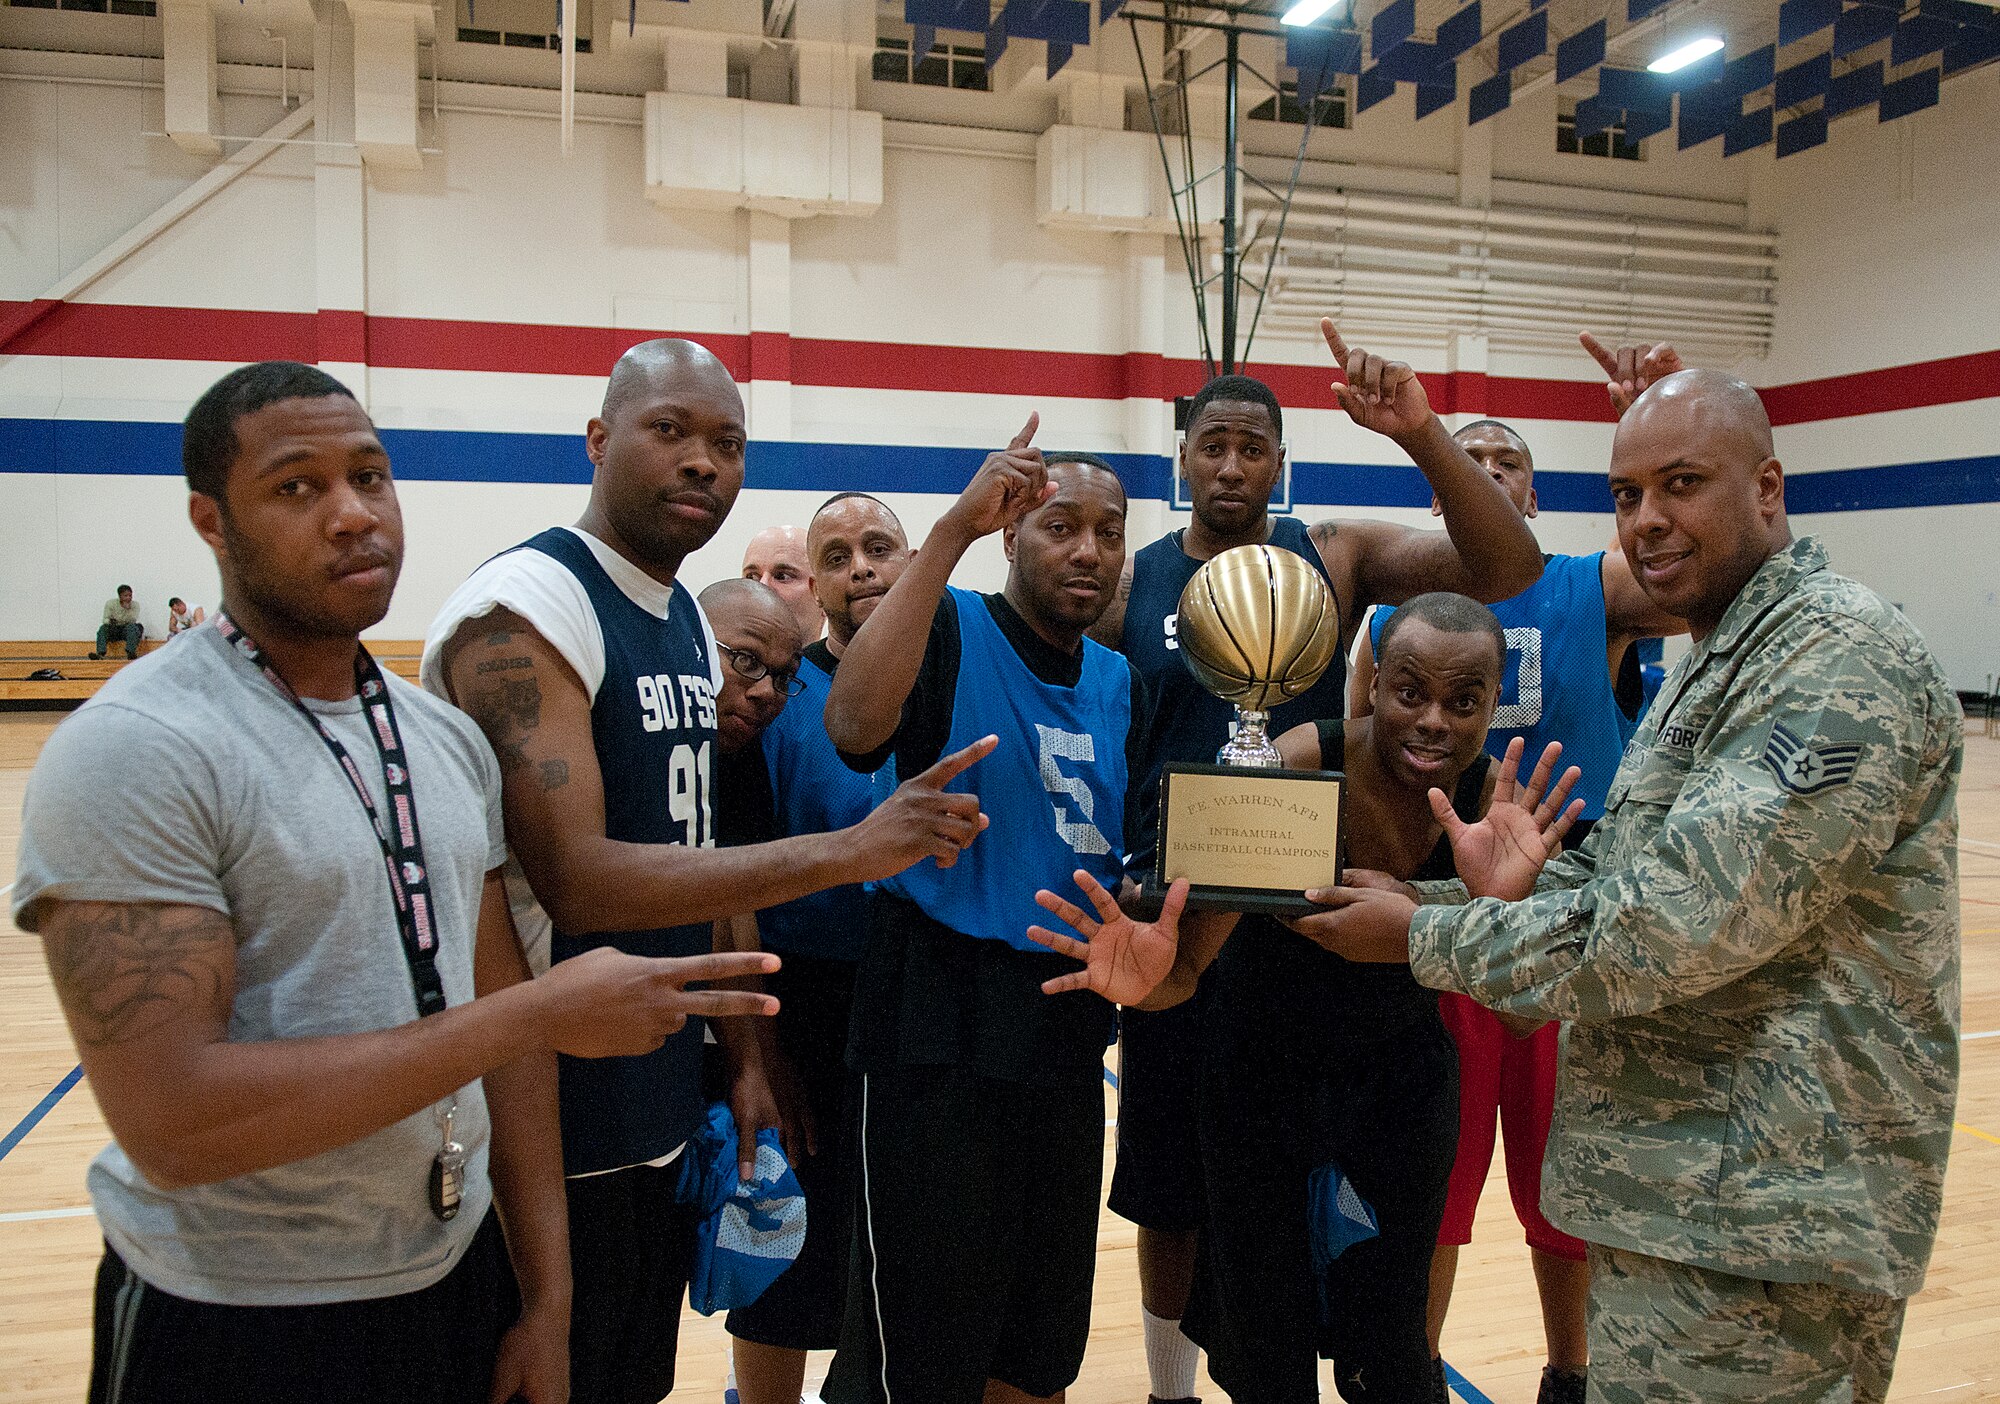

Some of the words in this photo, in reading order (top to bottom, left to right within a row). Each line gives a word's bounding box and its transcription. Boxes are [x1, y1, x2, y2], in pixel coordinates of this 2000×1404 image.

[637, 674, 679, 732] 90
[678, 674, 718, 730] FSS
[669, 741, 716, 848] 91
[1034, 723, 1112, 855] 5
[1213, 794, 1284, 808] WARREN
[1287, 803, 1319, 821] AFB
[1173, 841, 1251, 855] BASKETBALL
[1254, 846, 1330, 859] CHAMPIONS
[1209, 827, 1294, 840] INTRAMURAL
